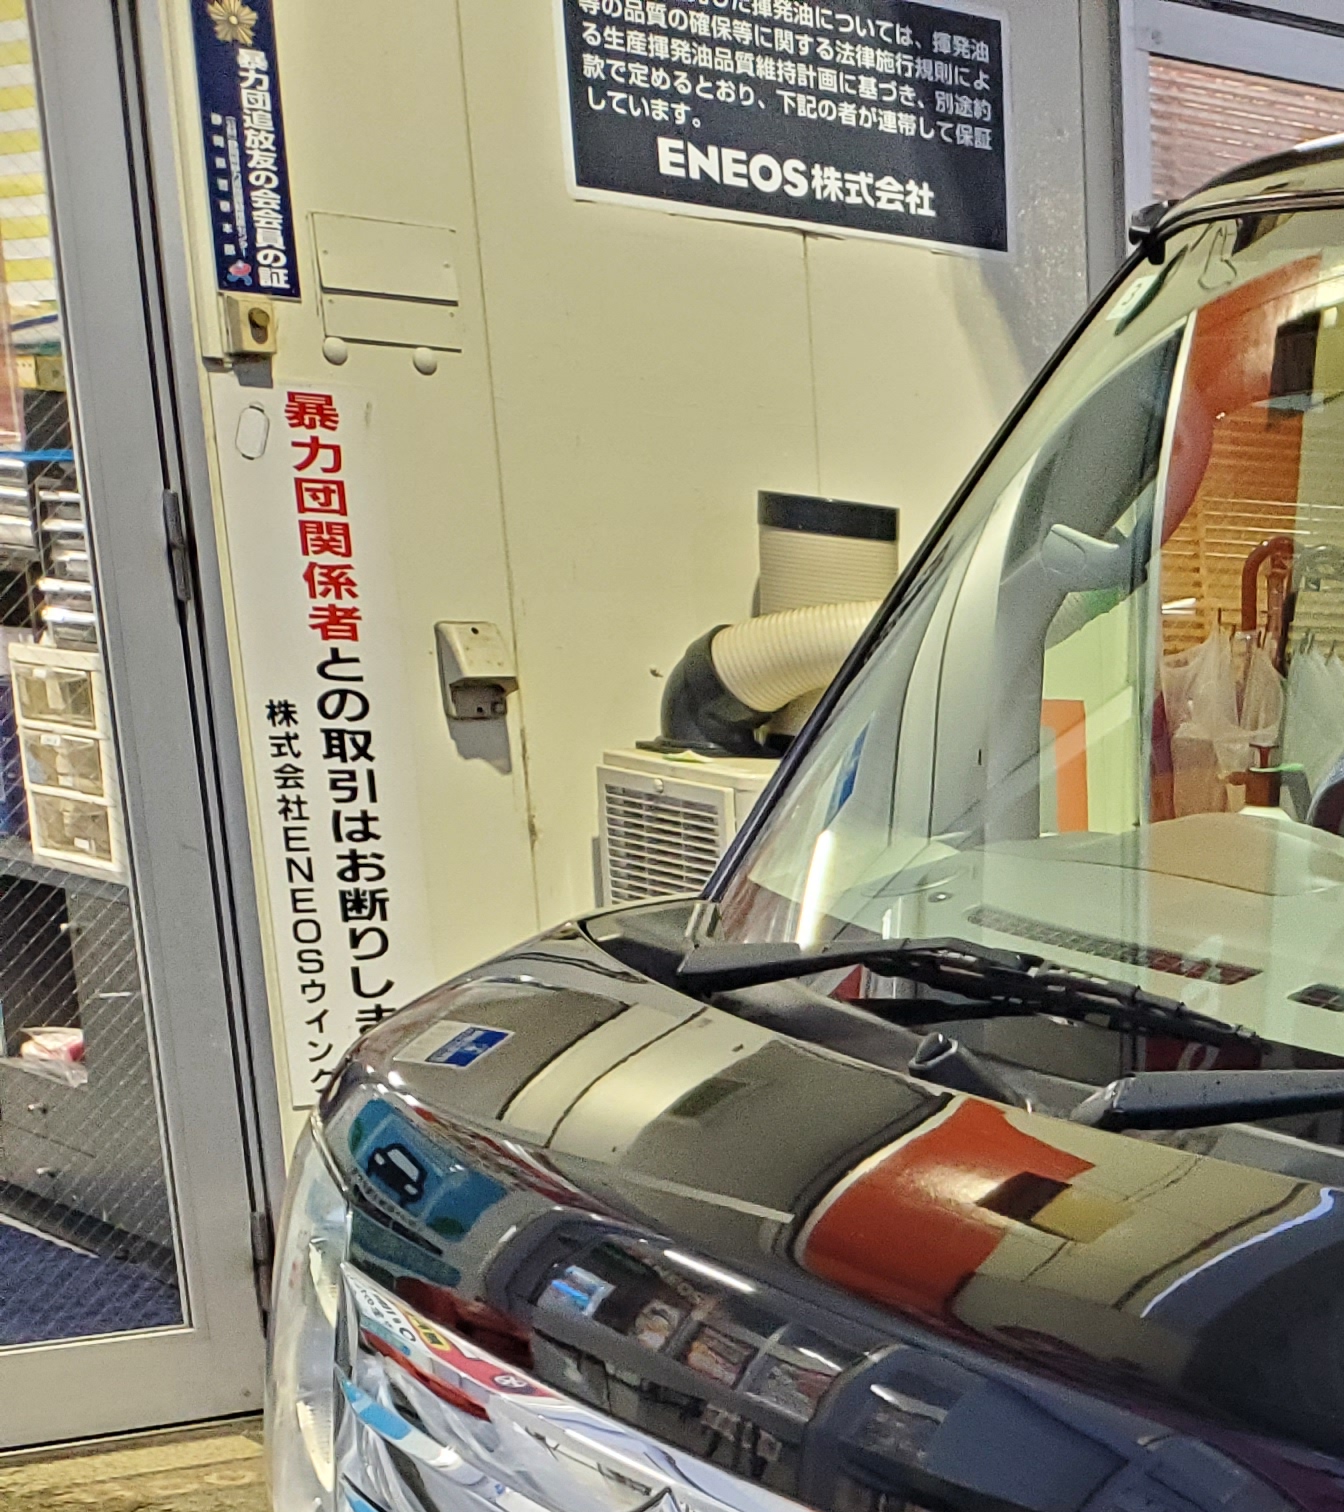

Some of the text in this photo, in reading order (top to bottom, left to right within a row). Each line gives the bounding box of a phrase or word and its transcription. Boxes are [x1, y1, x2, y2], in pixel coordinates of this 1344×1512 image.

[581, 21, 992, 121] る生産揮発油品質維持計画に基づき、別途約
[581, 53, 994, 151] 款で定めるとおり、下記の者が連帯して保証
[587, 86, 702, 129] しています。
[237, 48, 291, 289] 暴力団追放友の会会員の証
[656, 136, 937, 218] ENEOS株式会社
[284, 390, 397, 1035] 暴力団関係者との取引はお断りしま
